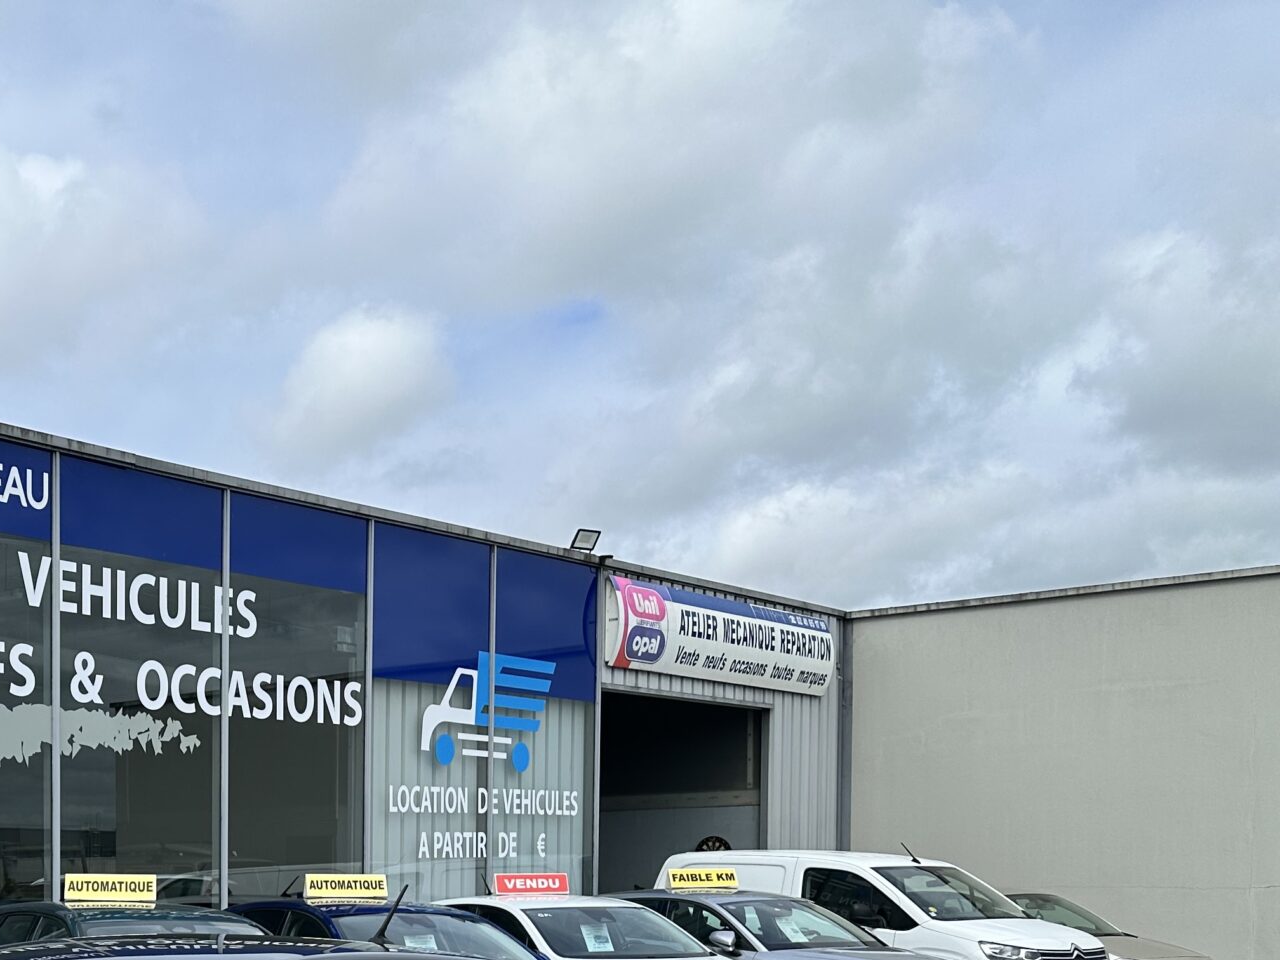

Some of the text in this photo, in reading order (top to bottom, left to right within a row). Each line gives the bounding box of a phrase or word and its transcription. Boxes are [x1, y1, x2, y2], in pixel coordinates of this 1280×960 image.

[17, 551, 258, 638] VEHICULES
[632, 591, 660, 616] Unil
[632, 634, 661, 657] opal
[679, 609, 719, 642] ATELIER
[723, 617, 776, 652] MECANIQUE
[780, 628, 832, 662] REPARATION
[674, 645, 828, 690] Vente neufs occasions toutes marques
[70, 652, 104, 704] &
[136, 659, 363, 727] OCCASIONS
[389, 784, 468, 814] LOCATION
[503, 788, 579, 816] VEHICULES
[418, 831, 546, 859] A PARTIR DE €
[67, 879, 154, 894] AUTOMATIQUE
[309, 879, 385, 891] AUTOMATIQUE
[503, 878, 561, 889] VENDU
[671, 872, 736, 883] FAIBLE KM
